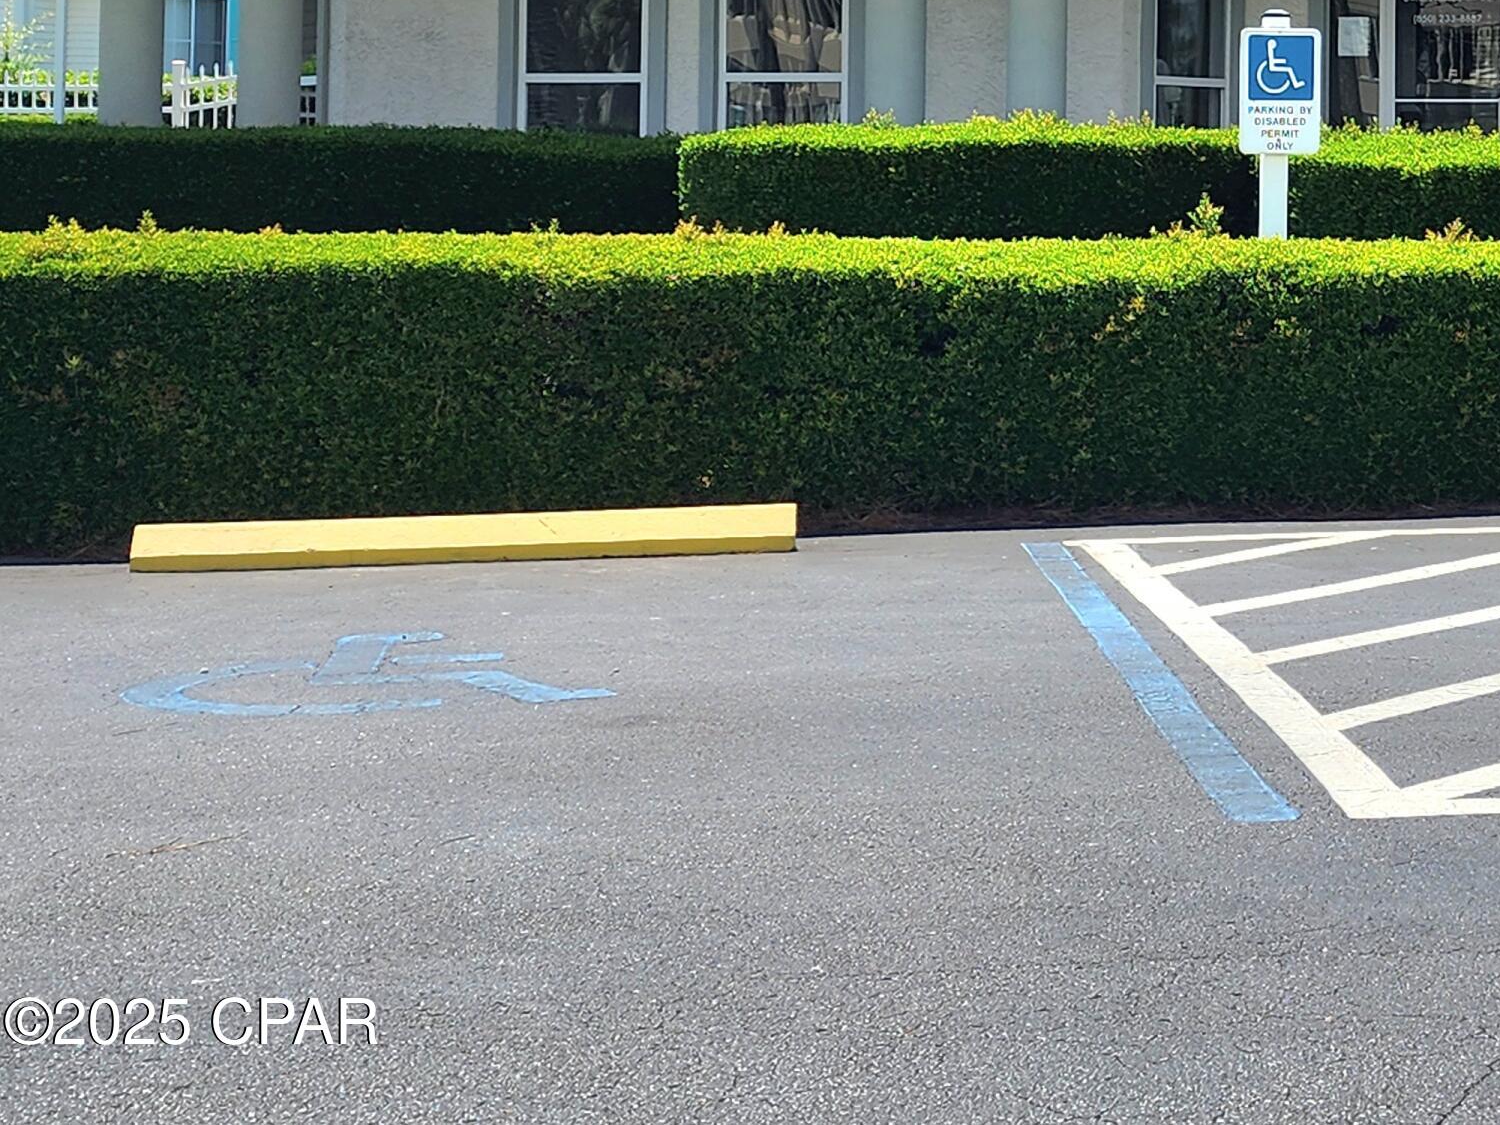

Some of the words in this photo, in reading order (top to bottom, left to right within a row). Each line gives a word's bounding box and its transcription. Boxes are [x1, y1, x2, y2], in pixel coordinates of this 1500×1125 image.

[1247, 106, 1294, 115] PARKING
[1299, 106, 1313, 115] BY
[1254, 117, 1306, 126] DISABLED
[1260, 129, 1300, 138] PERMIT
[1266, 141, 1294, 151] ONLY
